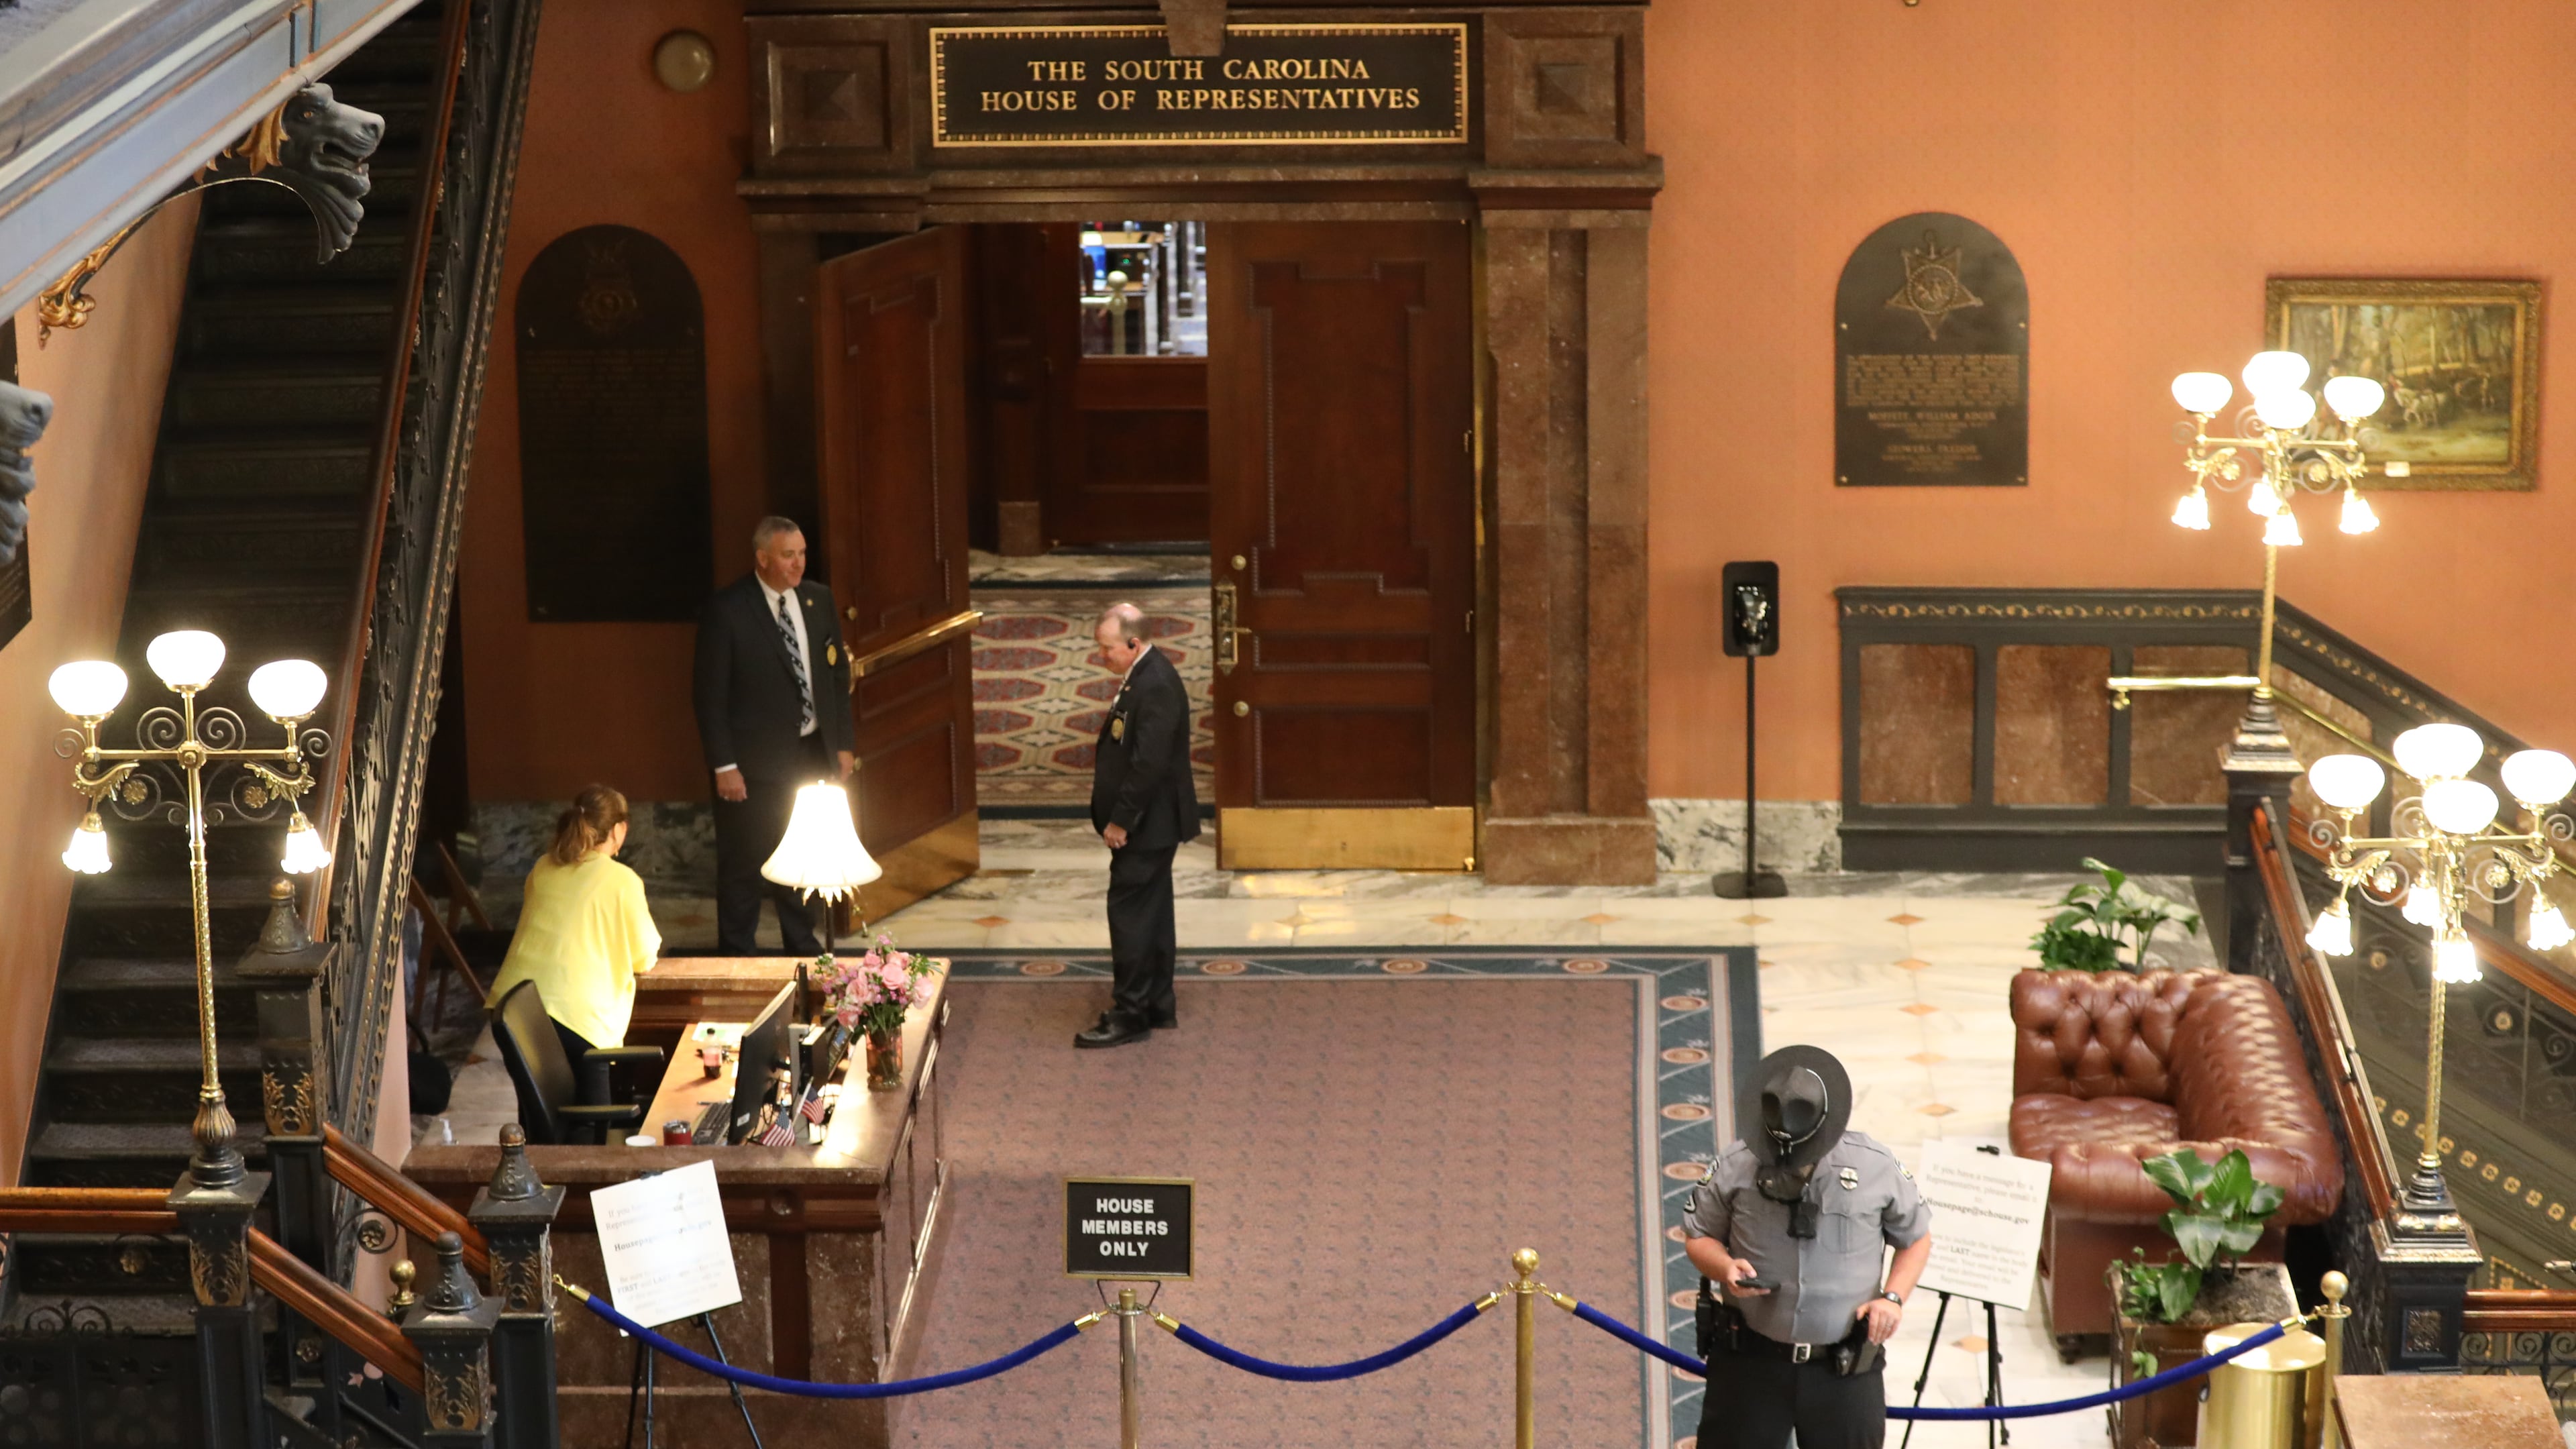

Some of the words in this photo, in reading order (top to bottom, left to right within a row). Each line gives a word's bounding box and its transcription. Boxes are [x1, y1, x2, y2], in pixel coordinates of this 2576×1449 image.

[1028, 61, 1087, 81] THE
[1106, 60, 1203, 80] SOUTH
[1223, 58, 1370, 80] CAROLINA
[981, 91, 1077, 111] HOUSE
[1098, 90, 1136, 111] OF
[1157, 88, 1420, 110] REPRESENTATIVES
[1096, 1198, 1155, 1214] HOUSE
[1927, 1197, 2029, 1225] Housepage@schouse.gov
[1082, 1220, 1169, 1236] MEMBERS
[1099, 1240, 1149, 1256] ONLY
[1950, 1244, 1970, 1256] LAST
